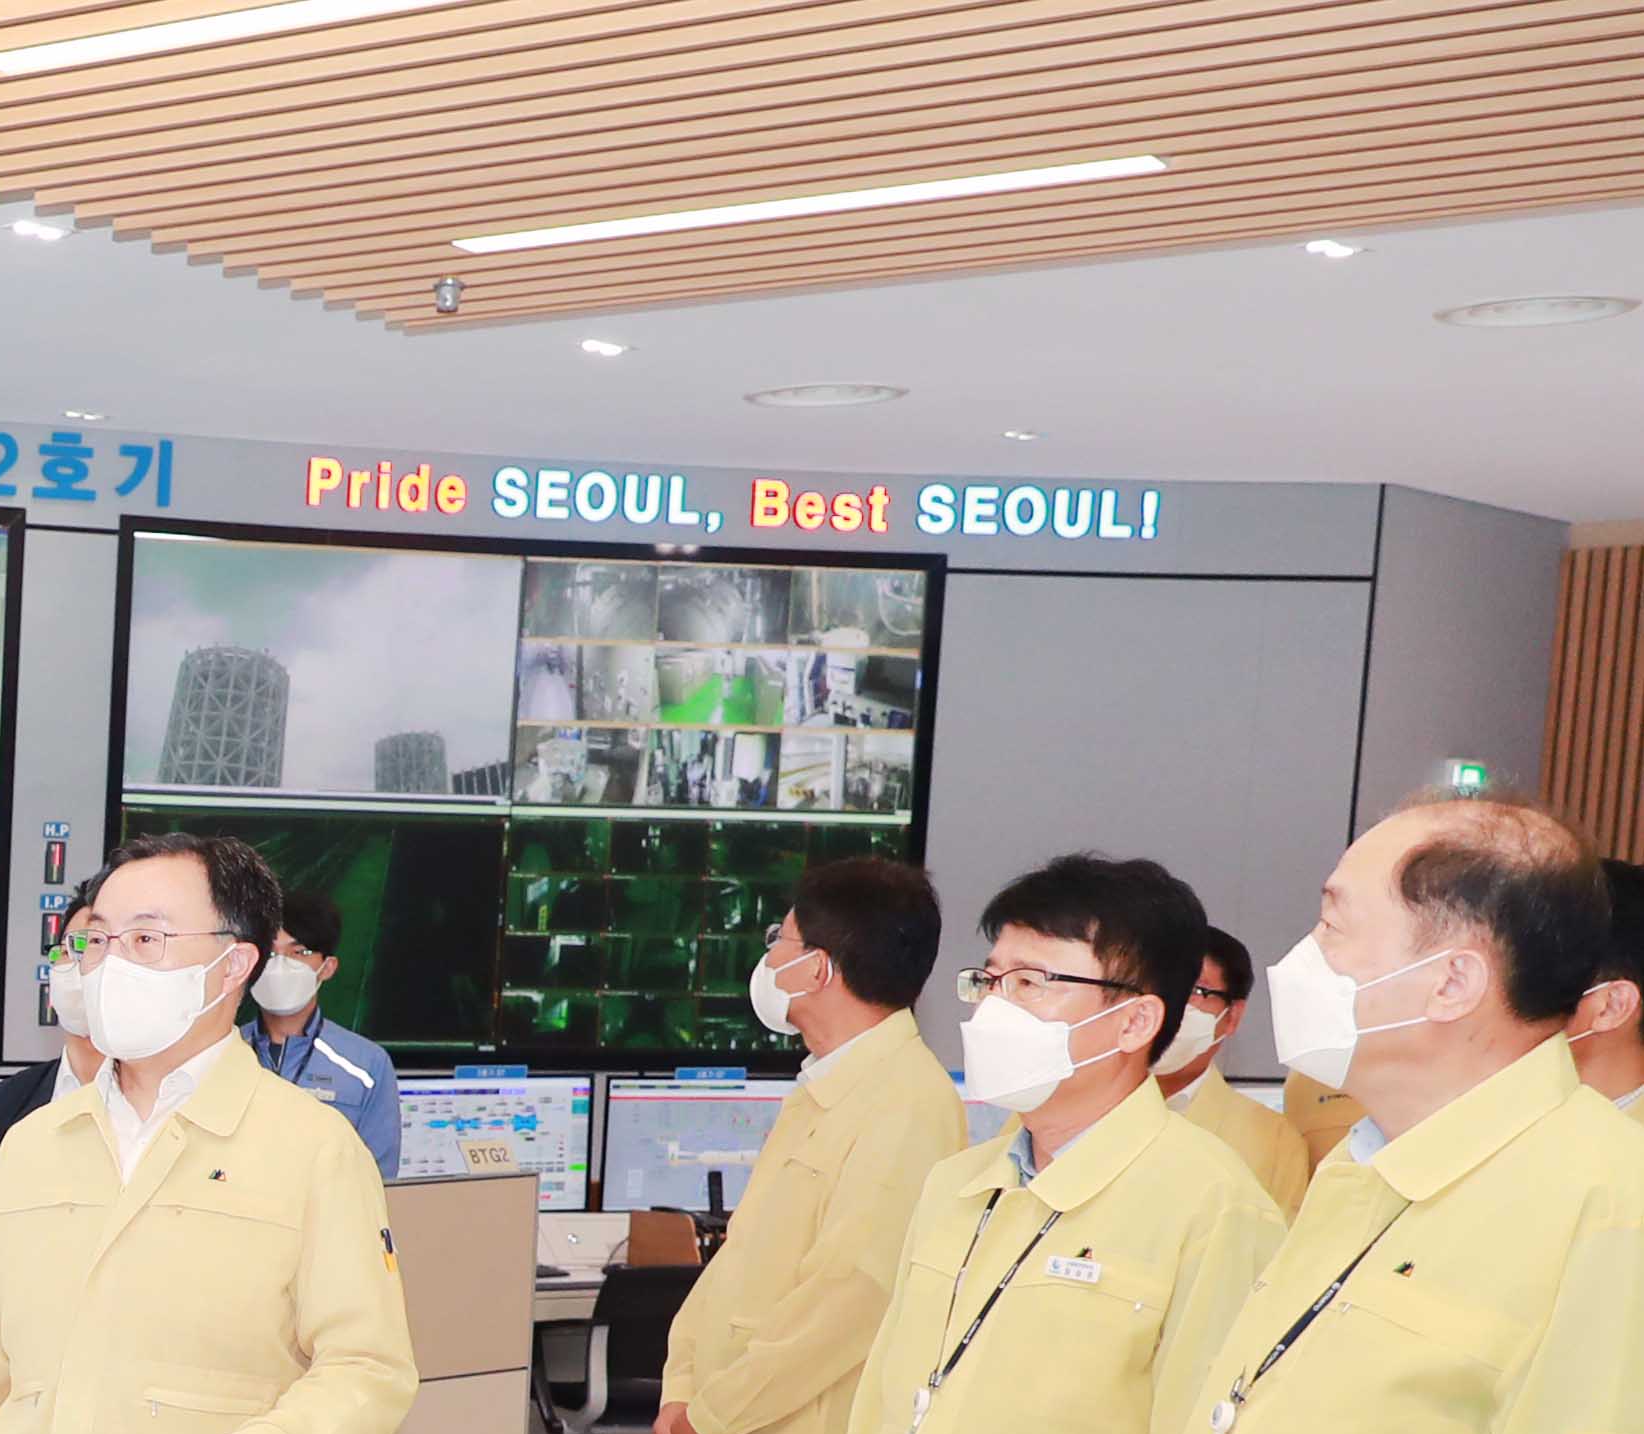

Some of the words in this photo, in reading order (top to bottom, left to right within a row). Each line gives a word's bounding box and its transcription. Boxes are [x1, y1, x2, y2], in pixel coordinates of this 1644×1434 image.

[306, 455, 467, 513] Pride
[492, 465, 723, 533] SEOUL,
[750, 477, 891, 532] Best
[915, 483, 1161, 539] SEOUL!
[45, 823, 69, 836] H.P
[470, 1147, 510, 1164] BTG2
